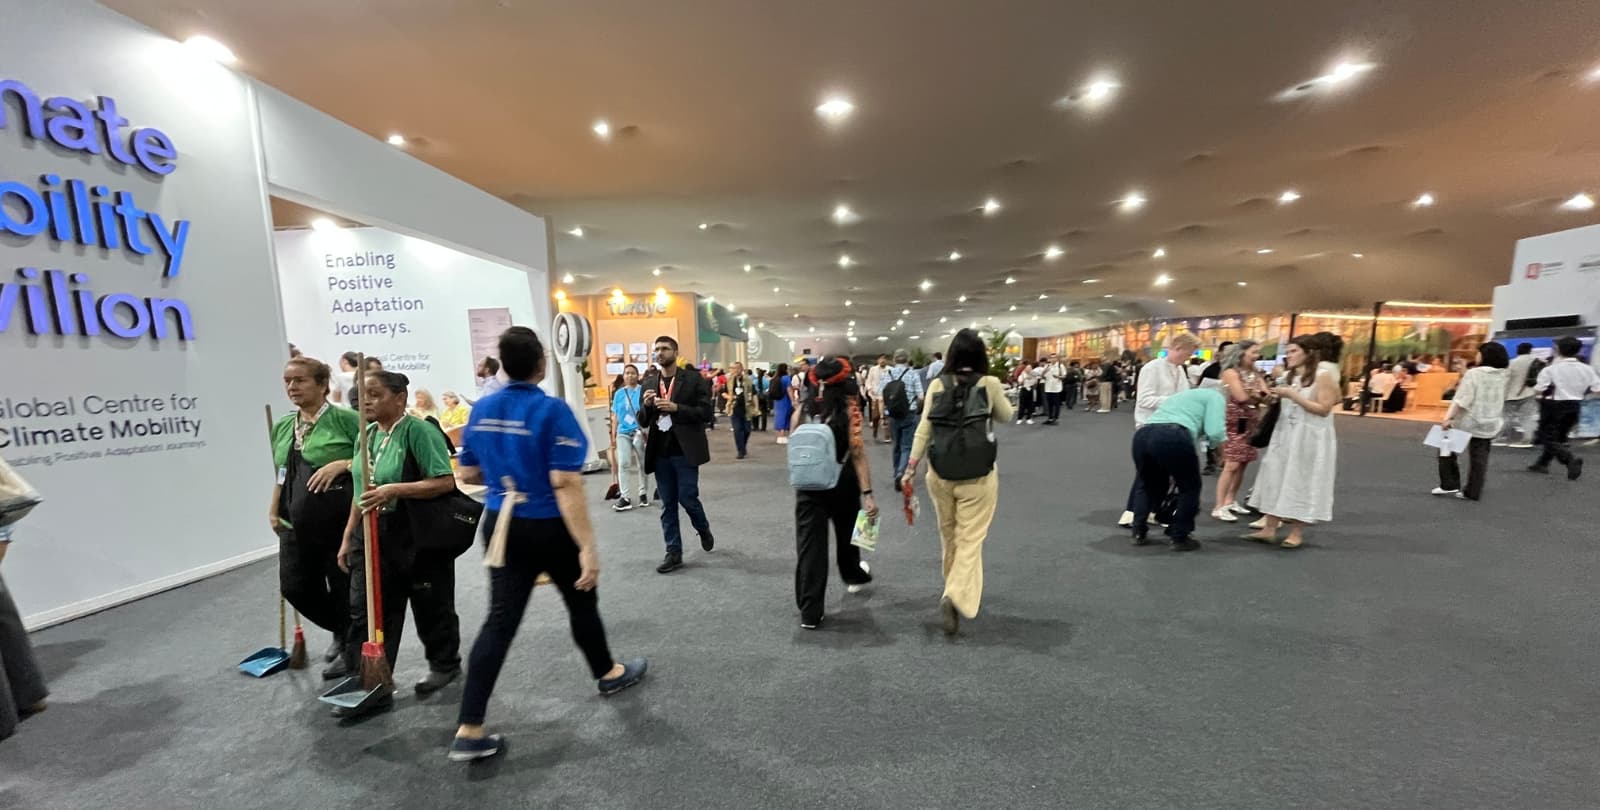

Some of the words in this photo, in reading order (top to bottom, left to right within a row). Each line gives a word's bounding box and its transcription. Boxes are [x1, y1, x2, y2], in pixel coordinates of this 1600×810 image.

[325, 252, 396, 269] Enabling
[327, 275, 393, 291] Positive
[331, 296, 424, 317] Adaptation
[335, 321, 411, 339] Journeys.
[83, 393, 165, 415] Centre
[170, 393, 199, 411] for
[109, 416, 202, 438] Mobility
